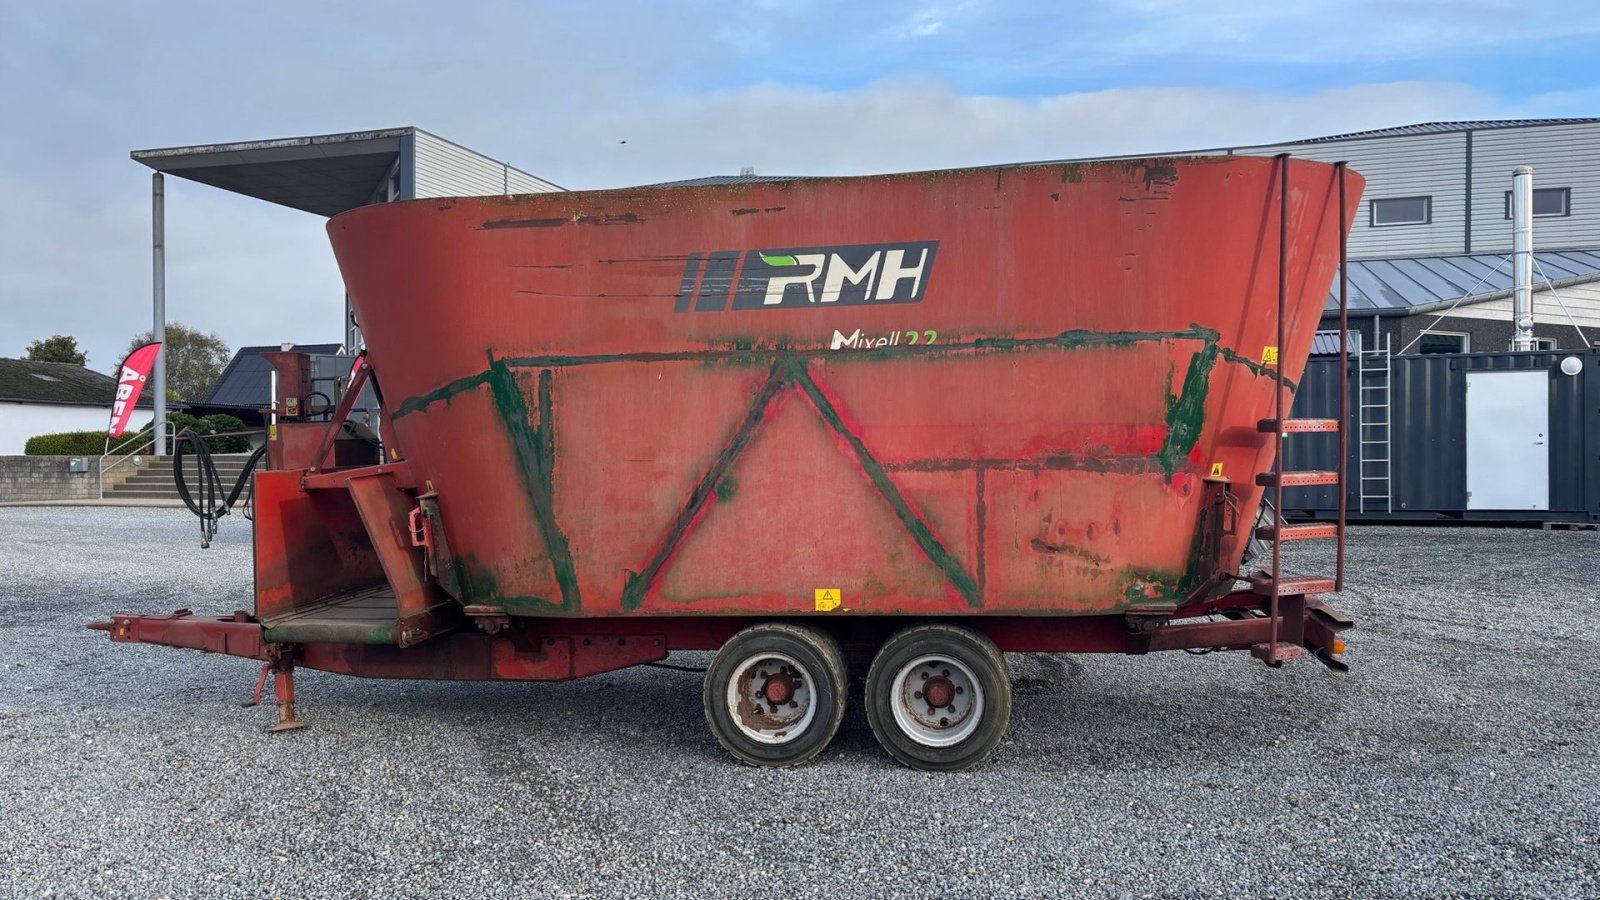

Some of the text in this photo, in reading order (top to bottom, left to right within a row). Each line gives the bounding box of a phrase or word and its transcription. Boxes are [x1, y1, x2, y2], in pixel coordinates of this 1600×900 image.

[760, 248, 928, 304] RMH
[830, 328, 901, 350] Mixell
[109, 365, 146, 434] ÅBEN
